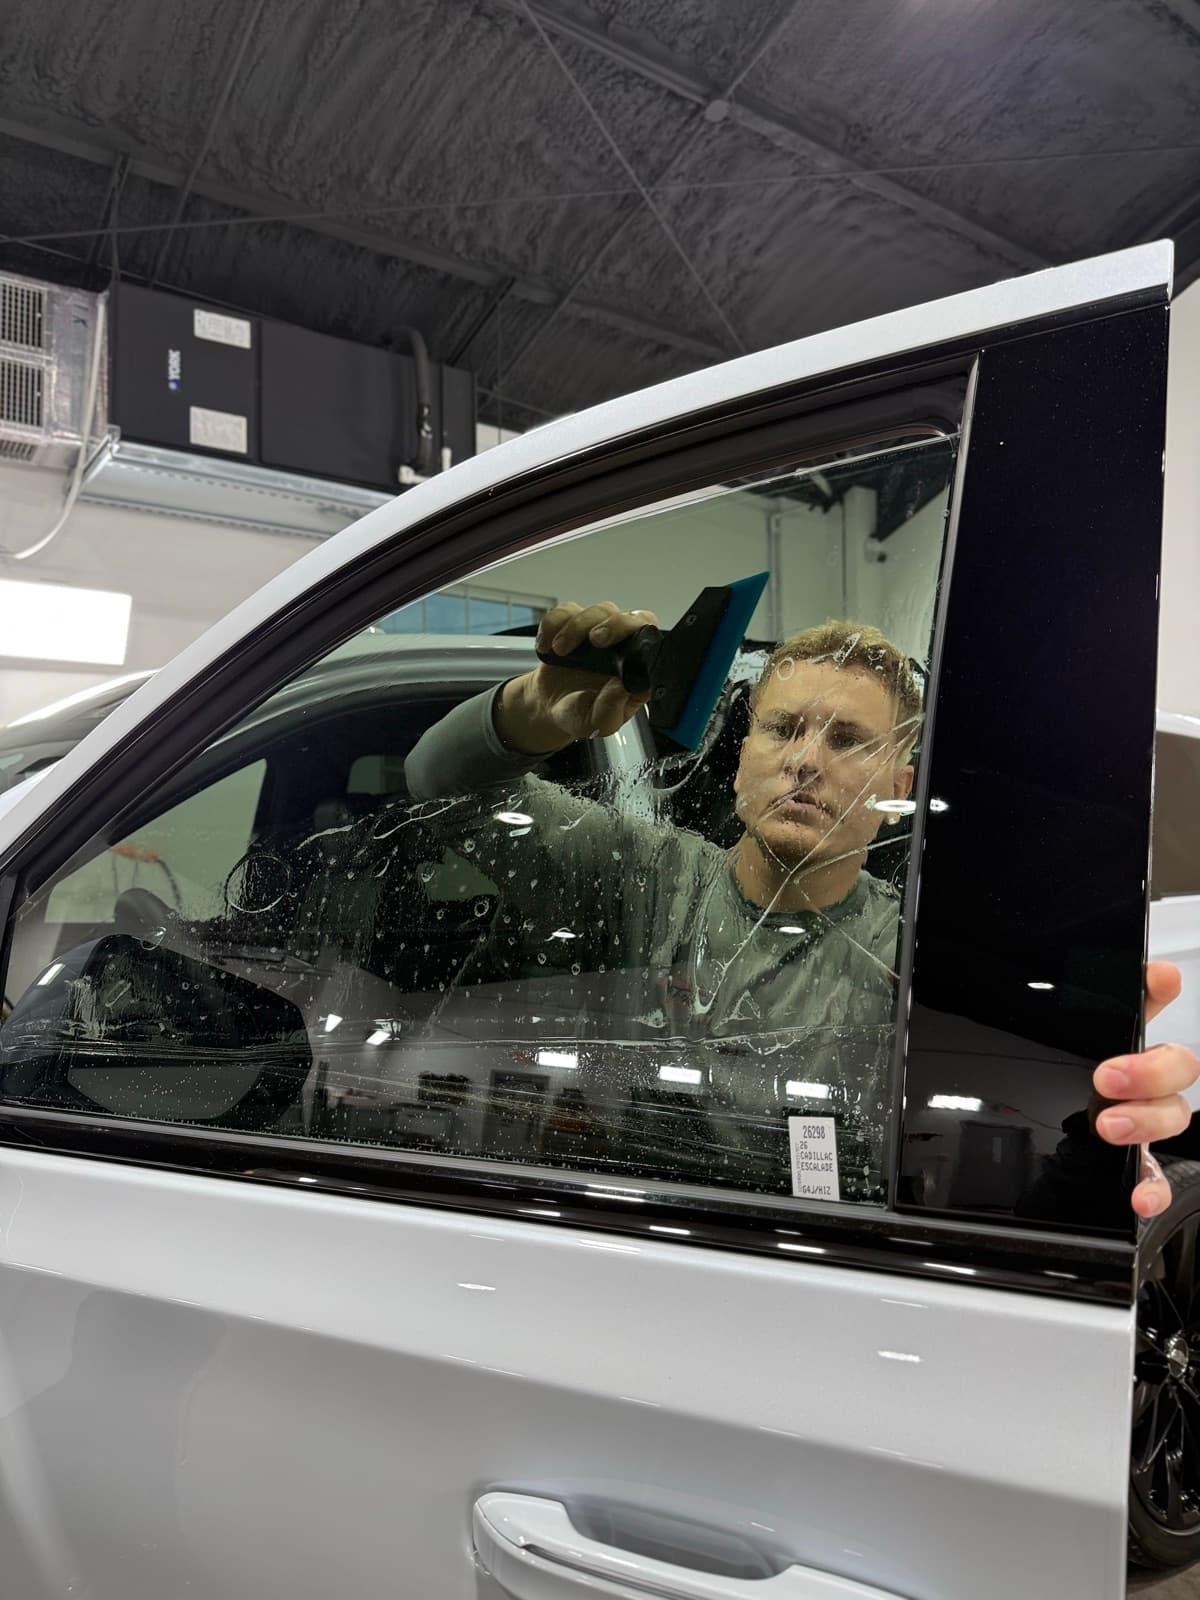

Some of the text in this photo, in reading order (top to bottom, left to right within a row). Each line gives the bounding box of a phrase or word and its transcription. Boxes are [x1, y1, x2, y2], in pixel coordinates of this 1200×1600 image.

[803, 1125, 826, 1139] 26298
[800, 1141, 808, 1150] 26
[800, 1151, 833, 1161] CADILLAC
[800, 1162, 834, 1172] ESCALADE
